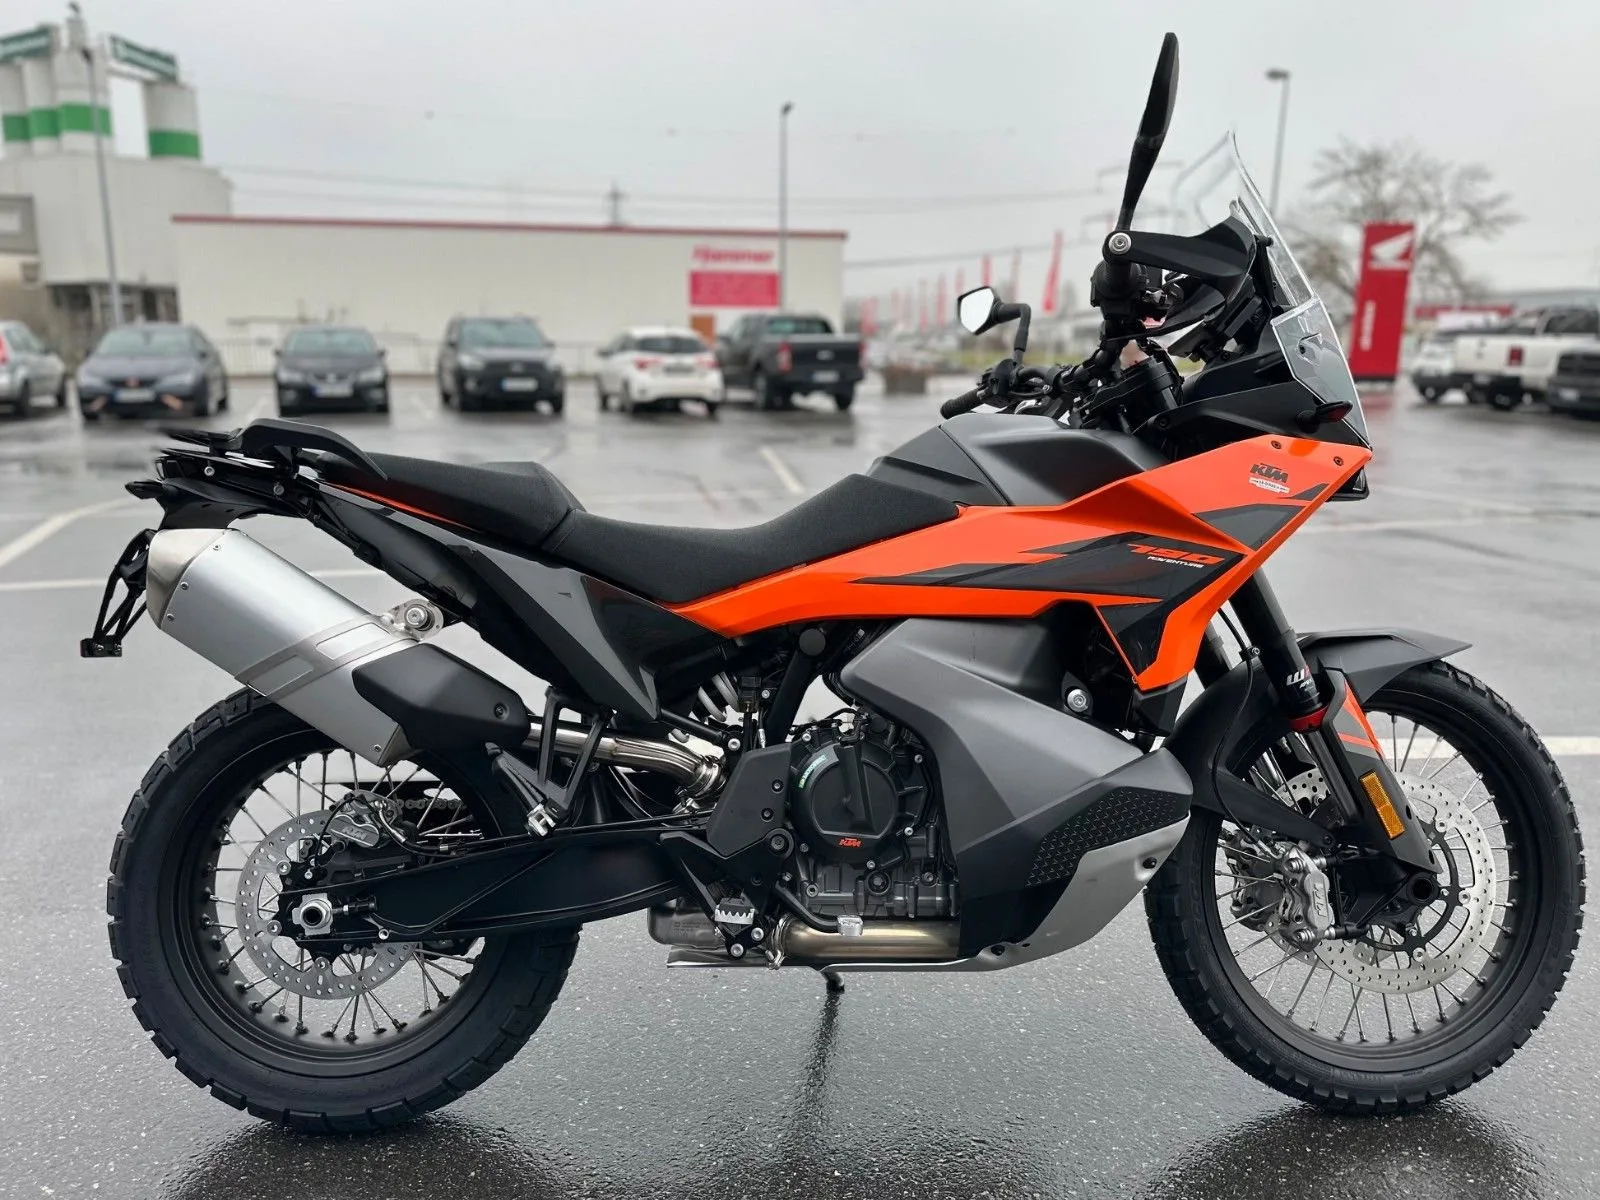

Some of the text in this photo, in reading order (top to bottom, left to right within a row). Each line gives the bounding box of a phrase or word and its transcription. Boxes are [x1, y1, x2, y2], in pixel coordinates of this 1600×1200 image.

[1250, 462, 1289, 483] KTM
[1127, 543, 1225, 565] 790
[1147, 556, 1204, 568] ADVENTURE
[839, 837, 861, 848] KTM
